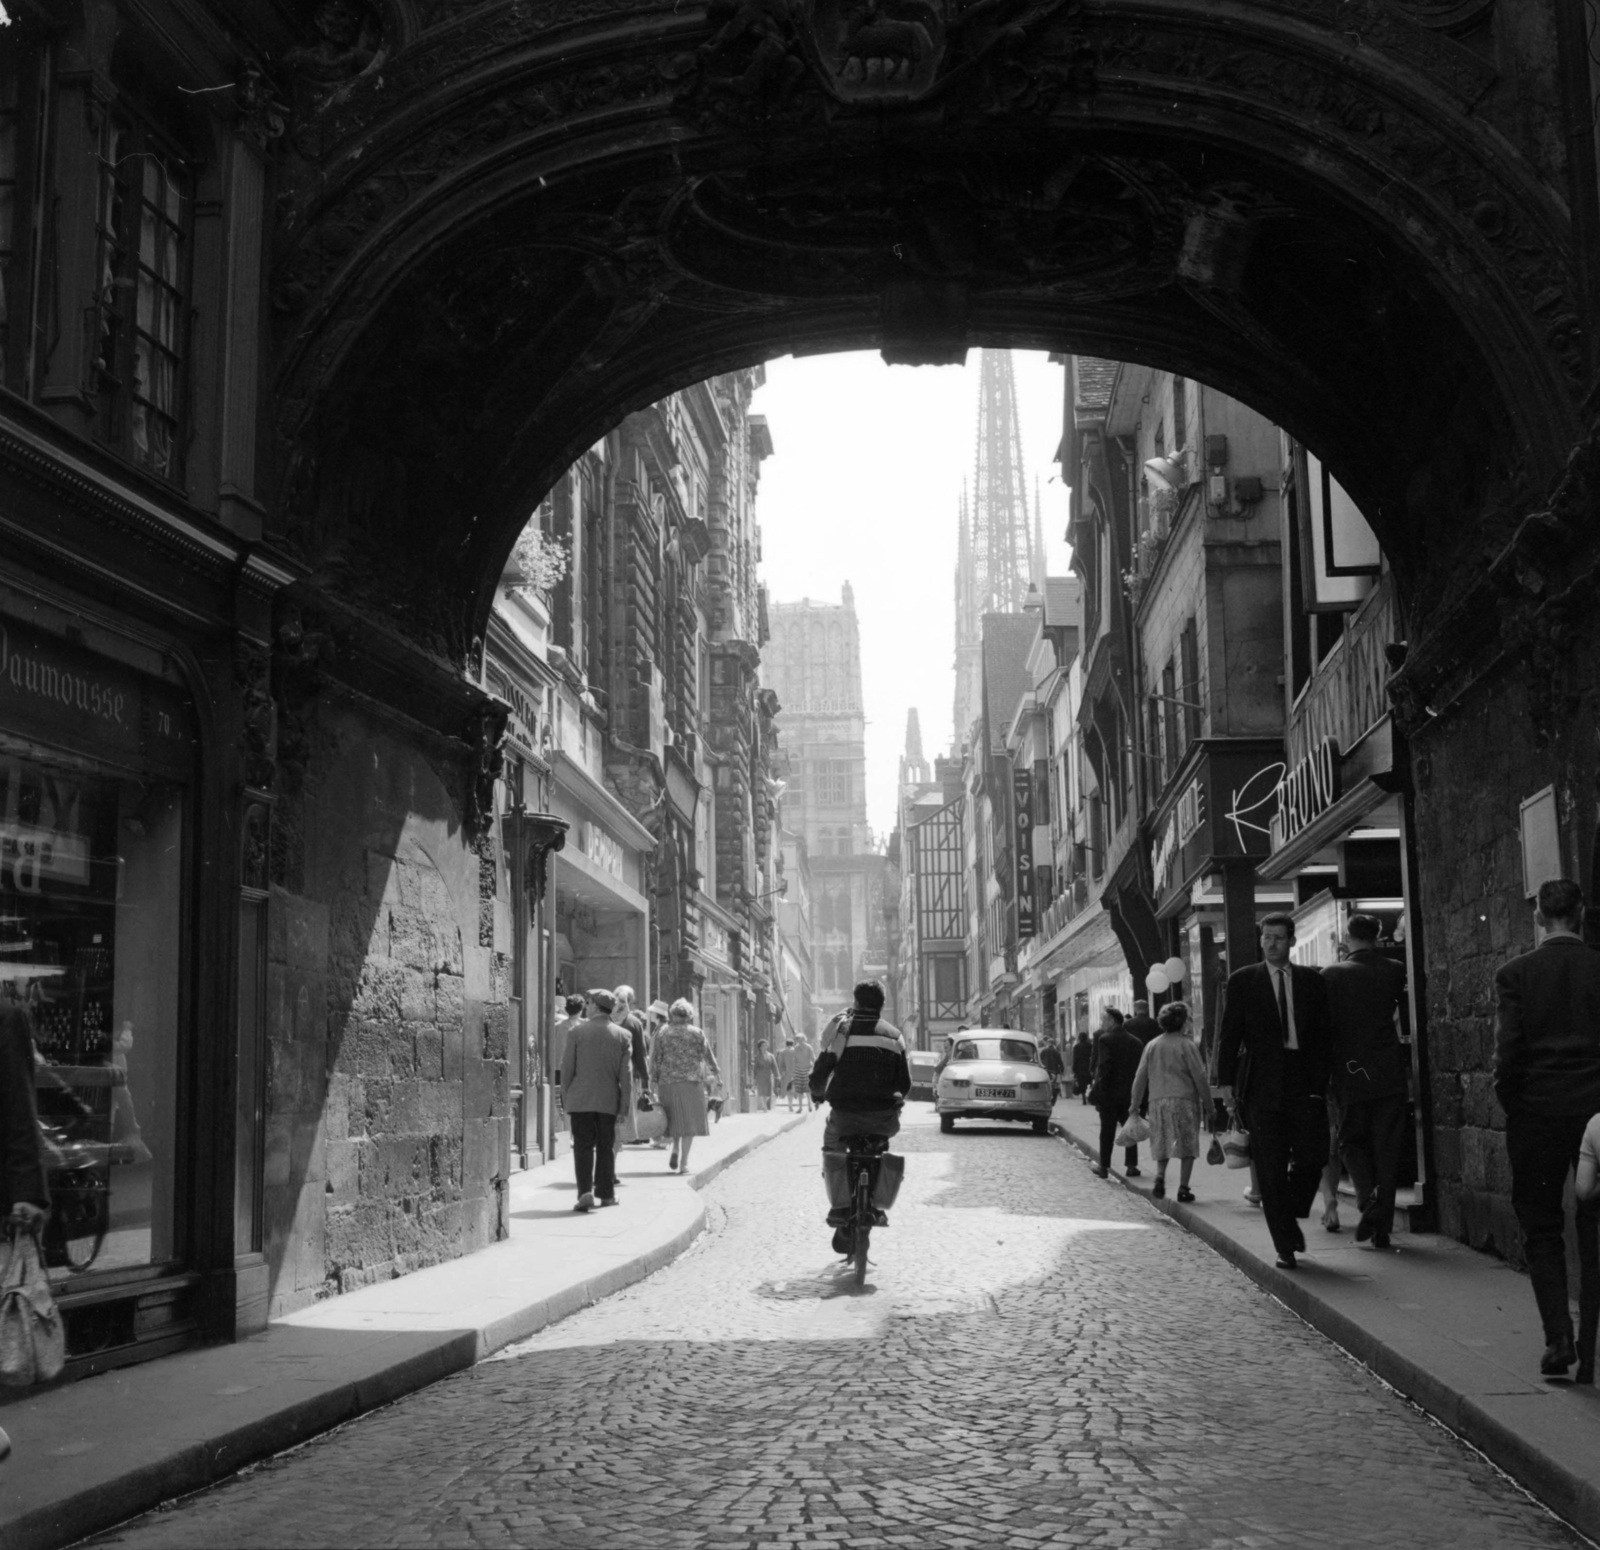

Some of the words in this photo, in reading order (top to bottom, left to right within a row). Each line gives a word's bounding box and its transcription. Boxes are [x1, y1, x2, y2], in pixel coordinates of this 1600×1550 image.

[158, 711, 170, 736] 70
[1277, 735, 1334, 849] BRUNO
[1015, 791, 1033, 913] VOISIN
